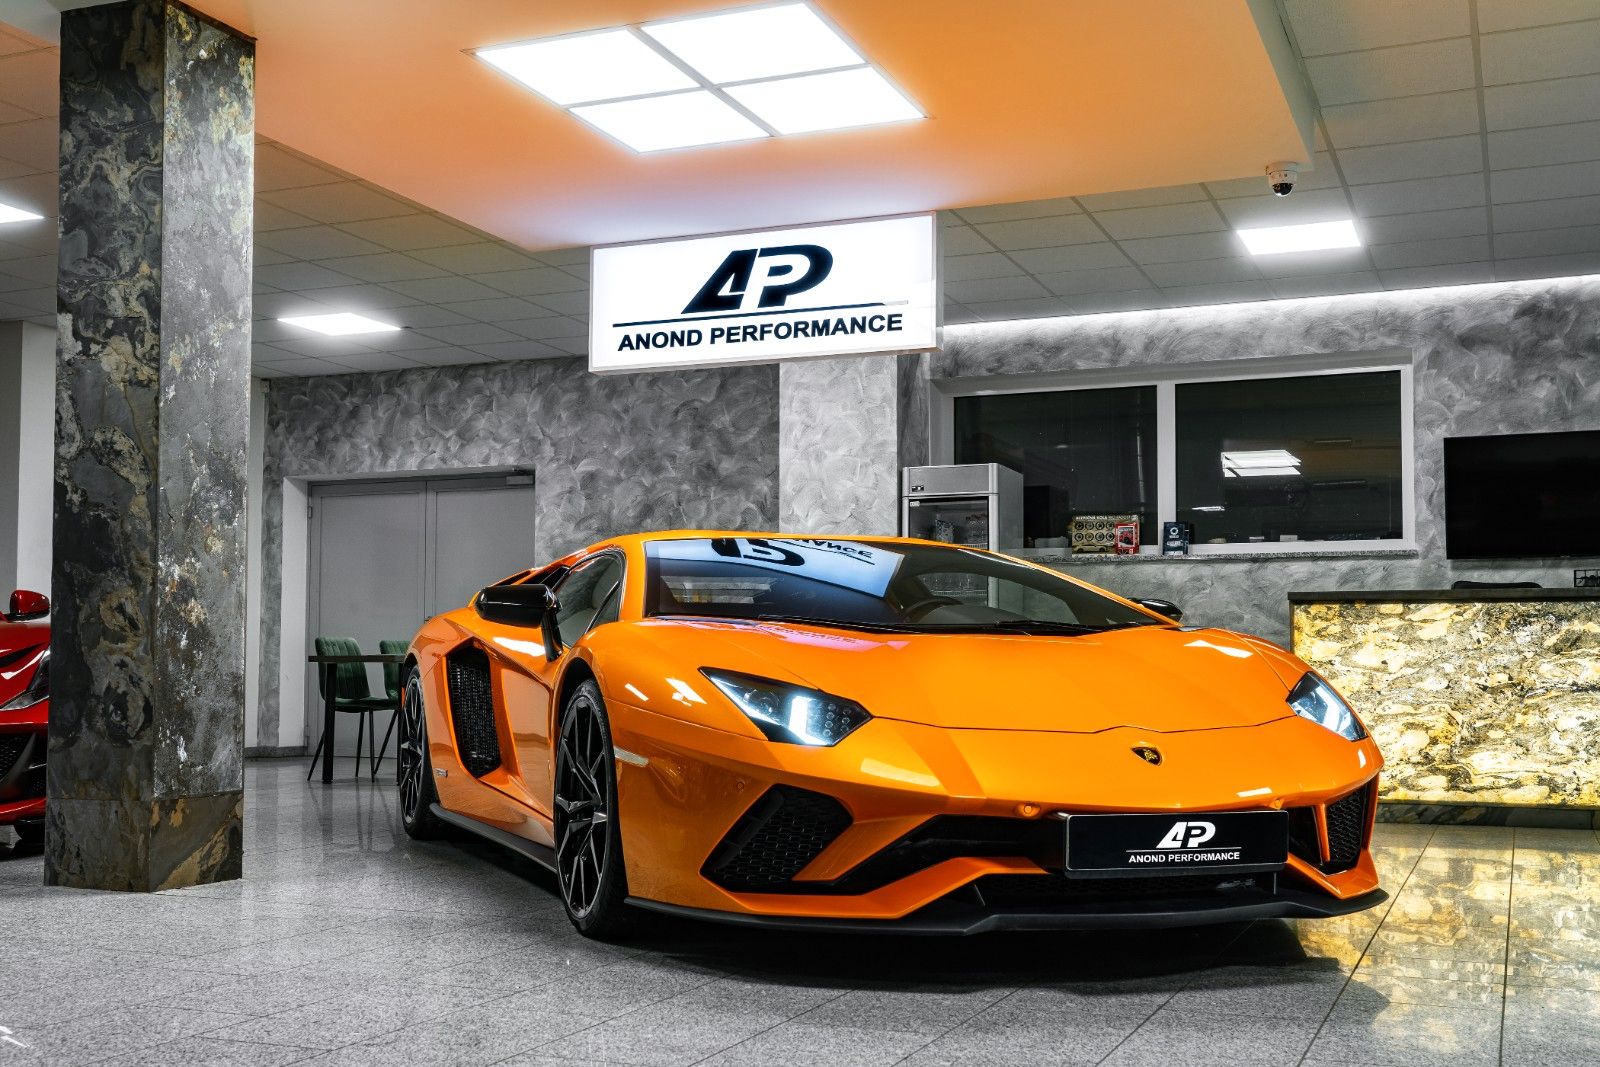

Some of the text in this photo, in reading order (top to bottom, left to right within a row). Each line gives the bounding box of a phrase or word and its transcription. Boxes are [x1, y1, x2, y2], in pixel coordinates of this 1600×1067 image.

[681, 244, 834, 315] AP
[617, 313, 903, 352] ANOND PERFORMANCE
[1155, 821, 1216, 849] AP
[1128, 851, 1240, 863] ANOND PERFORMANCE
